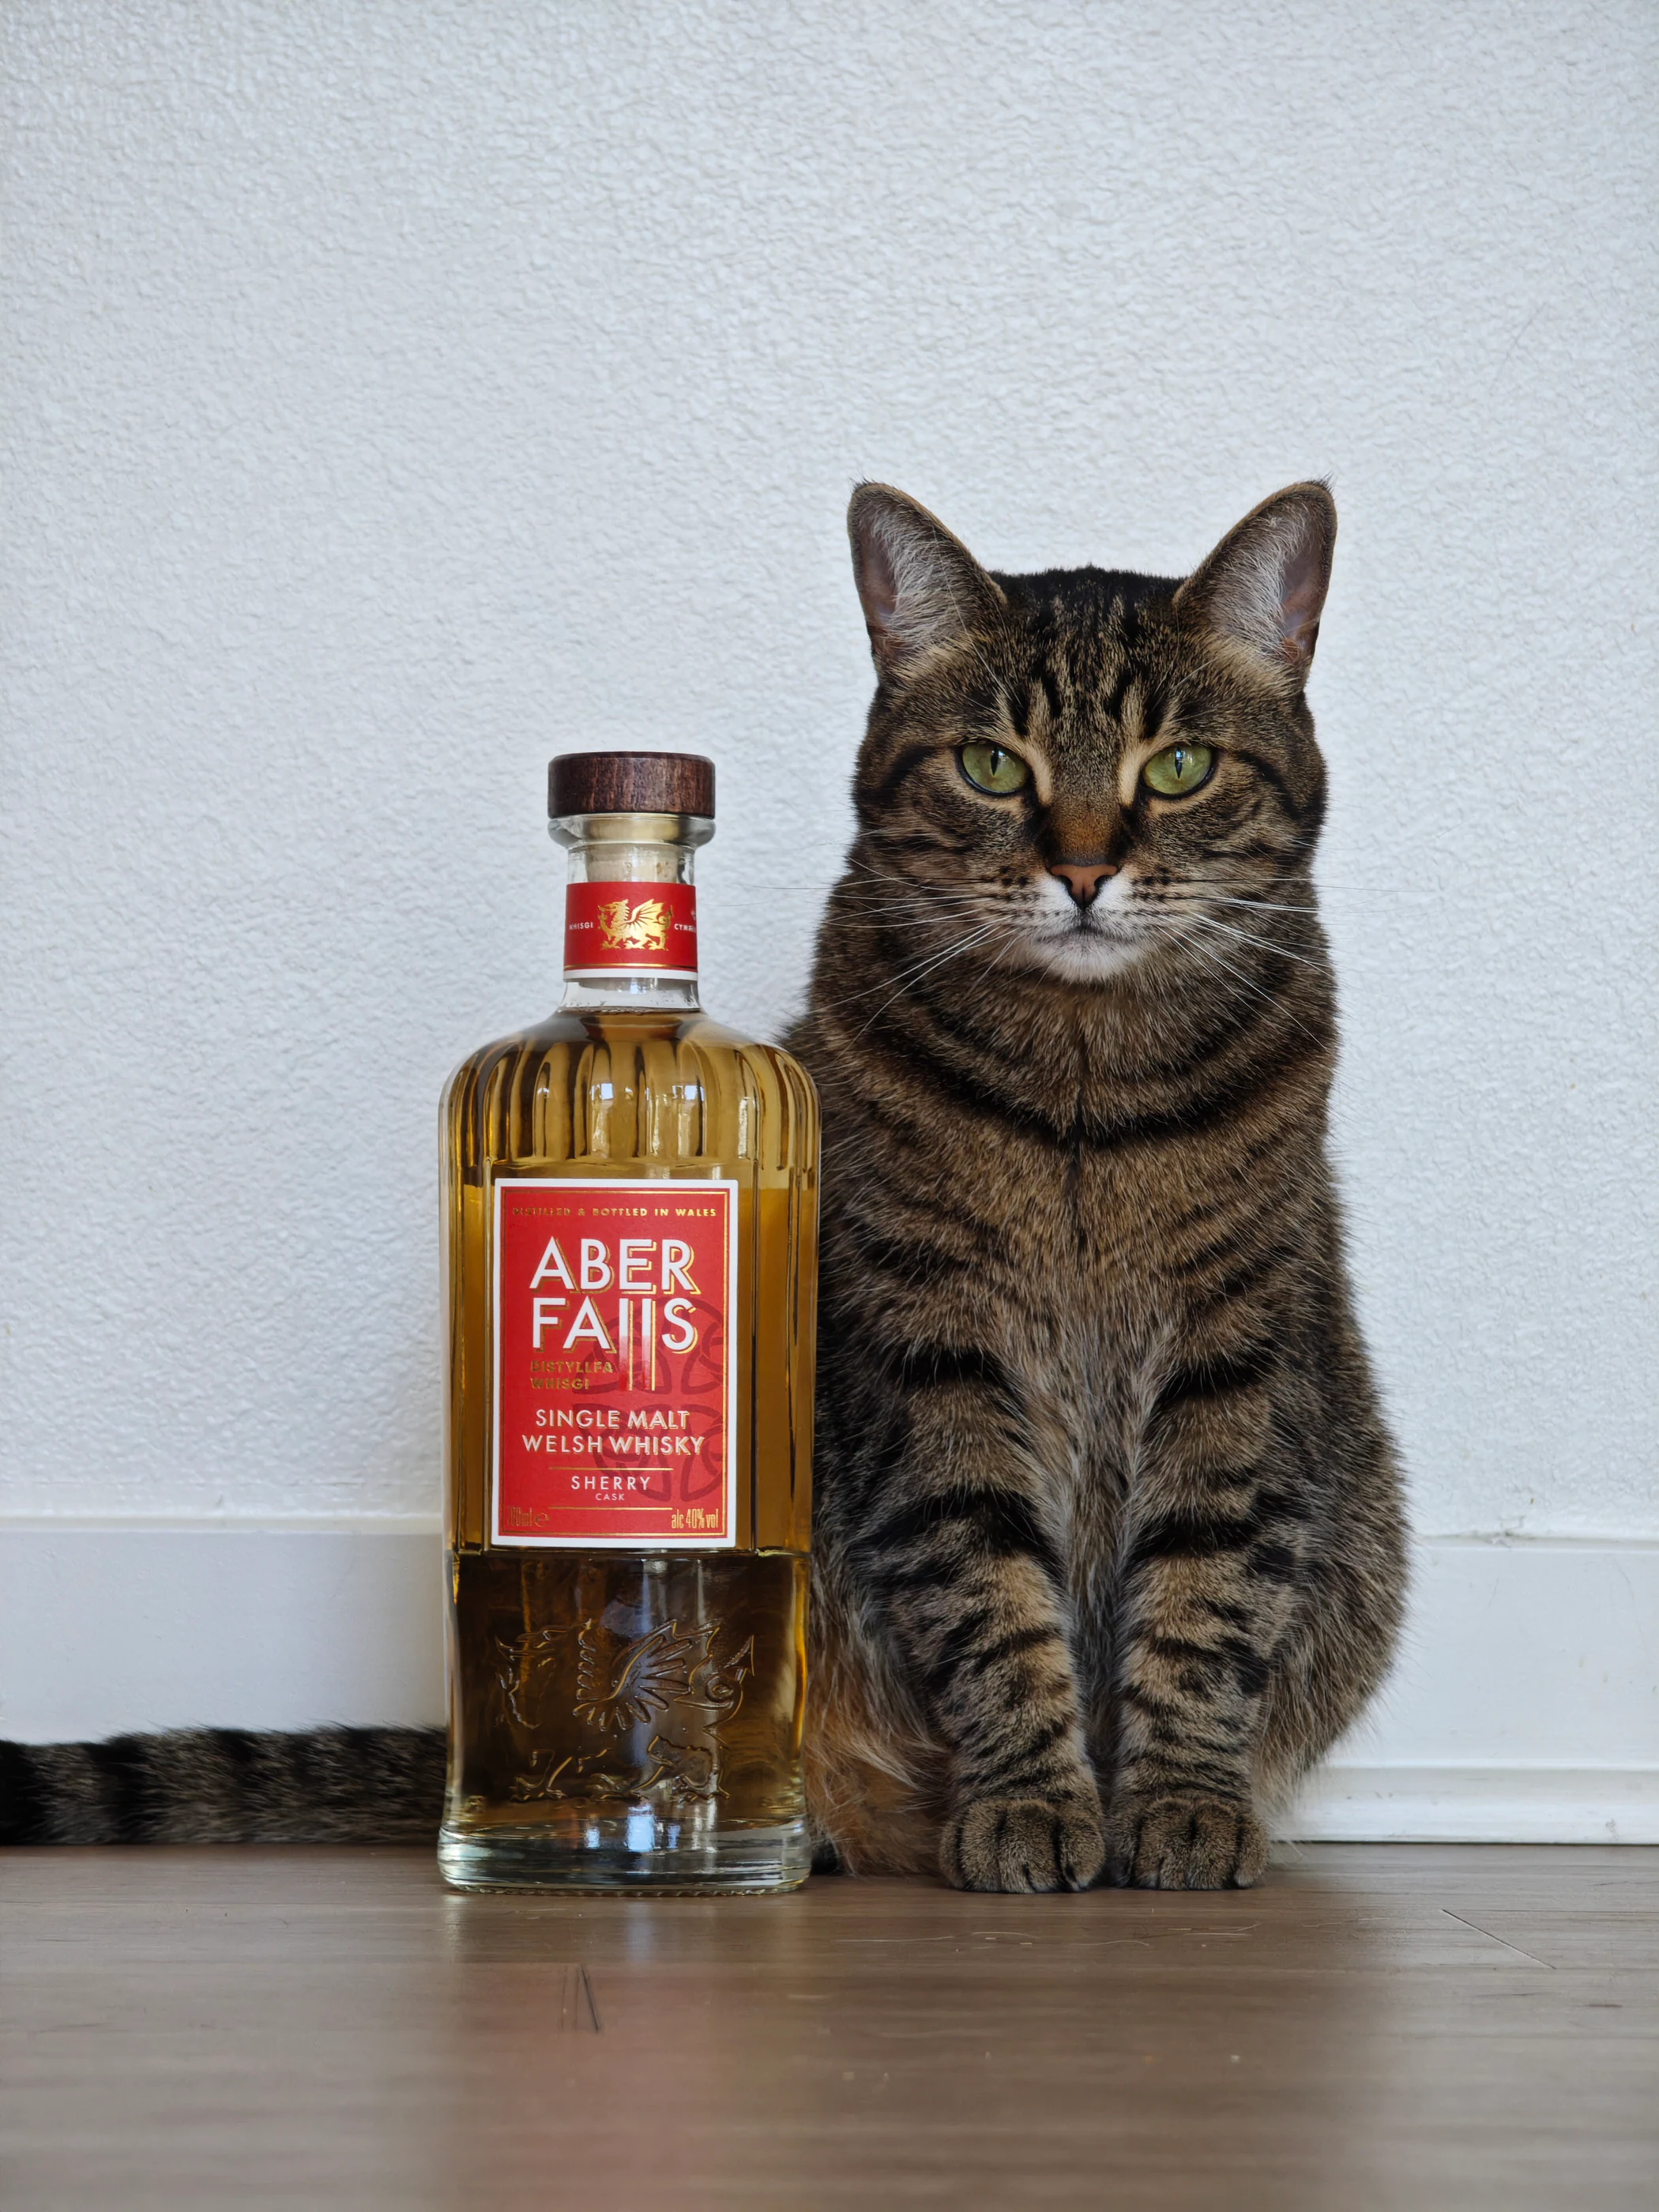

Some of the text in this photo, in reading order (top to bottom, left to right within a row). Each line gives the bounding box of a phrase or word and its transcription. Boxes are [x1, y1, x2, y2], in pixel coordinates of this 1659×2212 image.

[513, 1207, 717, 1217] DISTILLED & BOTTLED IN WALES
[529, 1236, 702, 1294] ABER
[532, 1296, 698, 1382] FALLS
[531, 1361, 614, 1373] DISTYLLFA
[530, 1378, 590, 1390] WHISGI
[536, 1409, 690, 1429] SINGLE MALT
[522, 1434, 705, 1456] WELSH WHISKY
[570, 1476, 651, 1491] SHERRY
[672, 1507, 719, 1529] alc 40% vol
